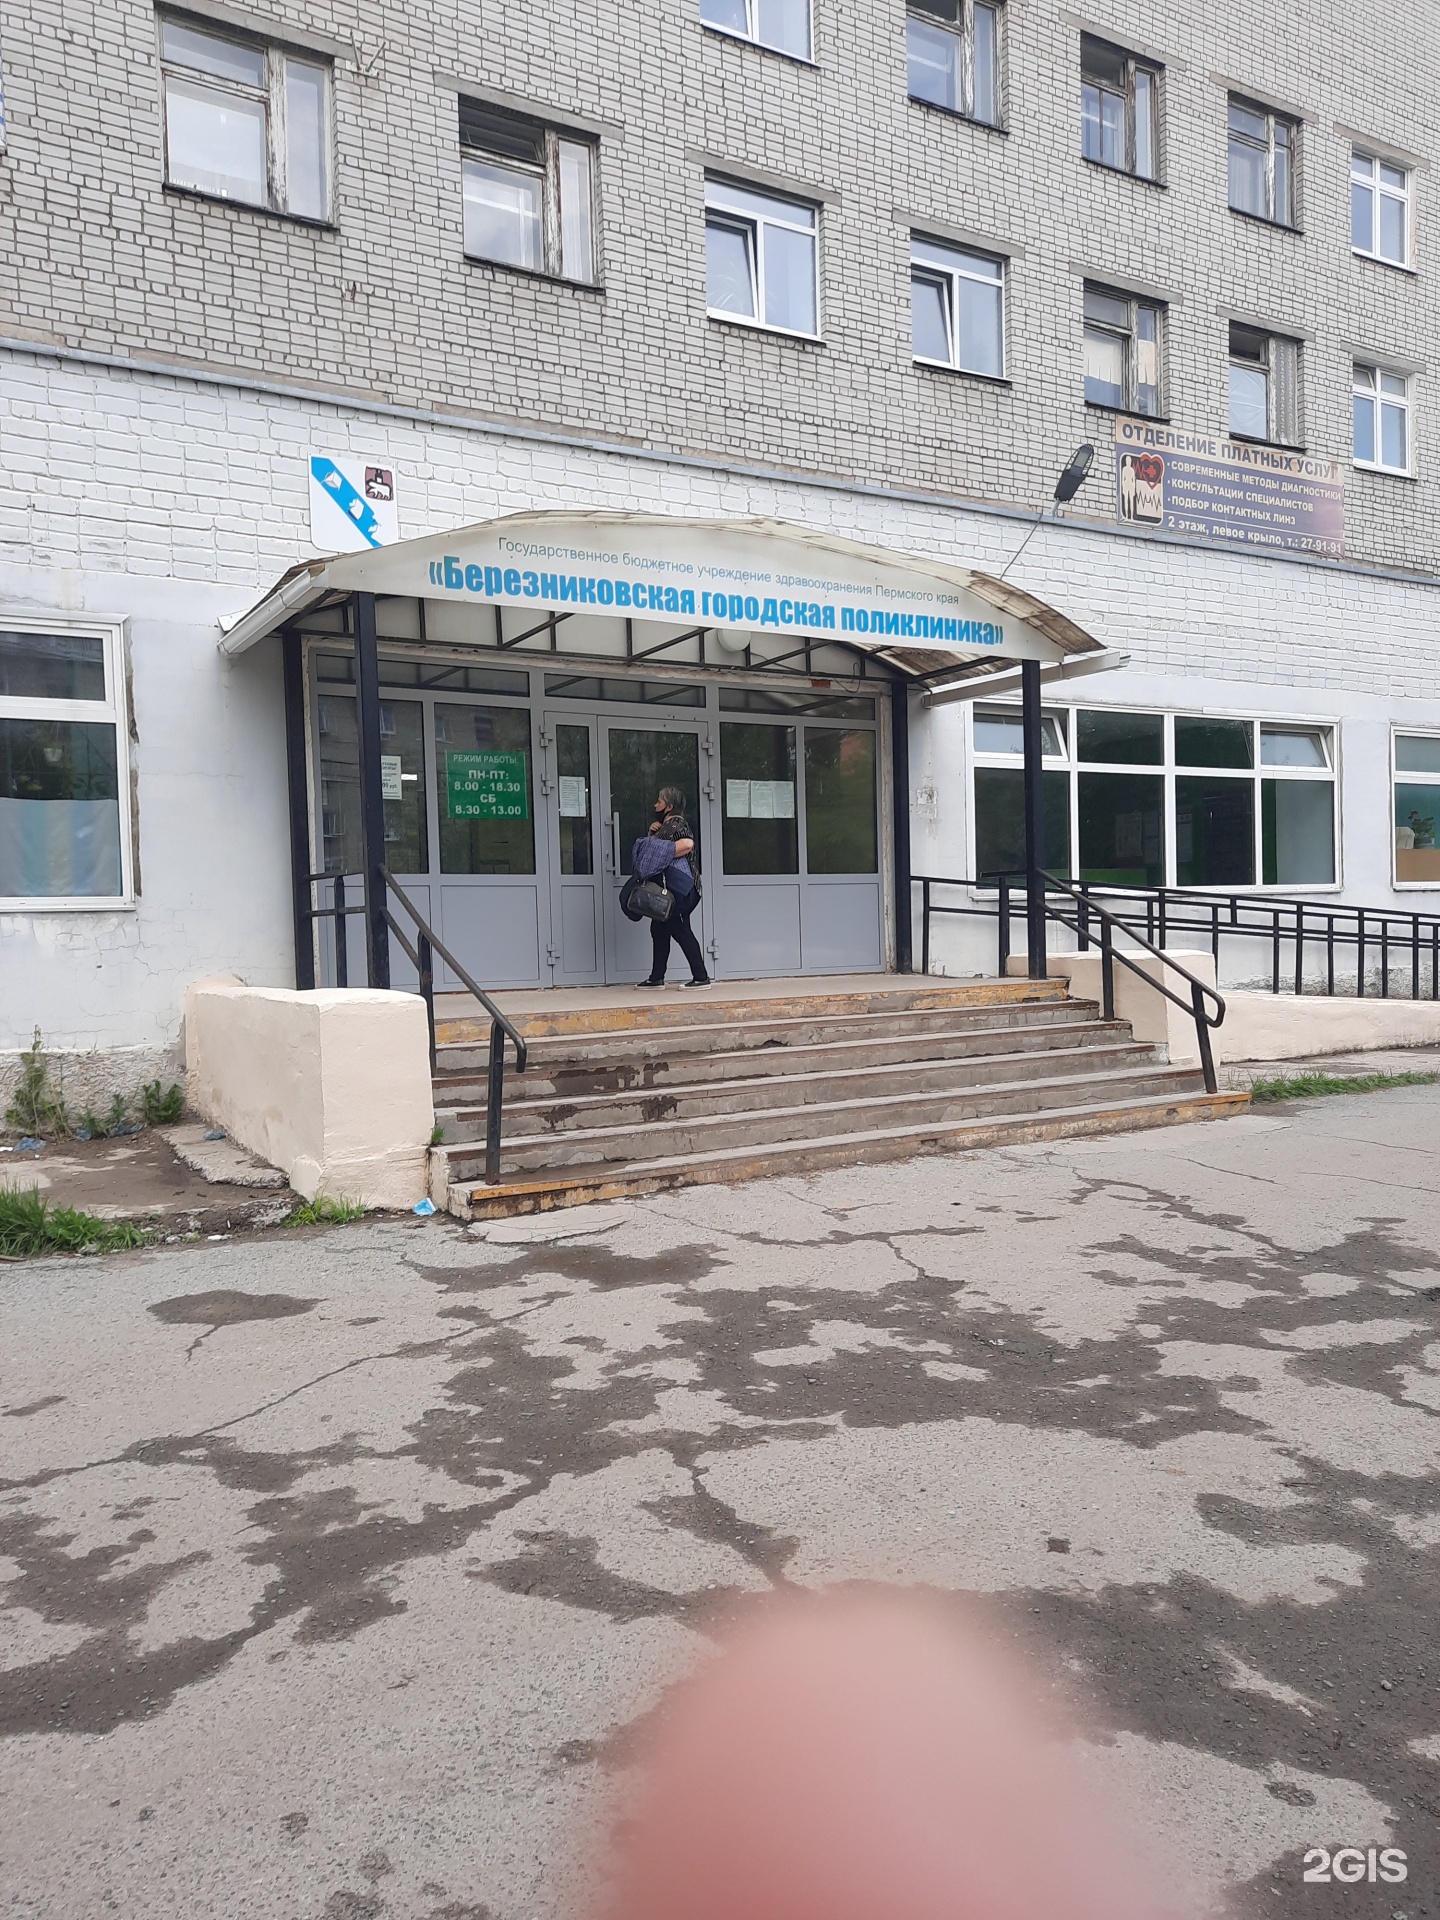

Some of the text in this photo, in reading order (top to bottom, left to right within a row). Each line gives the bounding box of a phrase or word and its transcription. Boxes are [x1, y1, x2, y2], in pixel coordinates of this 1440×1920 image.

[1122, 423, 1339, 480] ОТДЕЛЕНИЕ ПЛАТНЫХ УСЛУГ
[1171, 460, 1341, 501] СОВРЕМЕННЫЕ МЕТОДЫ ДИАГНОСТИКИ
[1171, 478, 1314, 512] КОНСУЛЬТАЦИИ СПЕЦИАЛИСТОВ
[1171, 496, 1296, 526] ПОДБОР КОНТАКТНЫХ ЛИНЗ
[1168, 516, 1175, 527] 2
[1178, 520, 1209, 536] этаж,
[1212, 524, 1245, 538] левое
[1247, 531, 1284, 546] крыло,
[1301, 538, 1341, 554] 27-91-91
[498, 537, 959, 606] Государственное бюджетное учреждение здравоохранения Пермского края
[429, 555, 1003, 645] «Березниковская городская поликлиника»
[453, 755, 482, 763] РЕЖИМ
[468, 770, 509, 779] ПН-ПТ:
[454, 782, 478, 791] 8.00
[490, 782, 520, 791] 18.30
[480, 794, 496, 803] СБ
[455, 805, 479, 814] 8.30
[491, 806, 521, 815] 13.00
